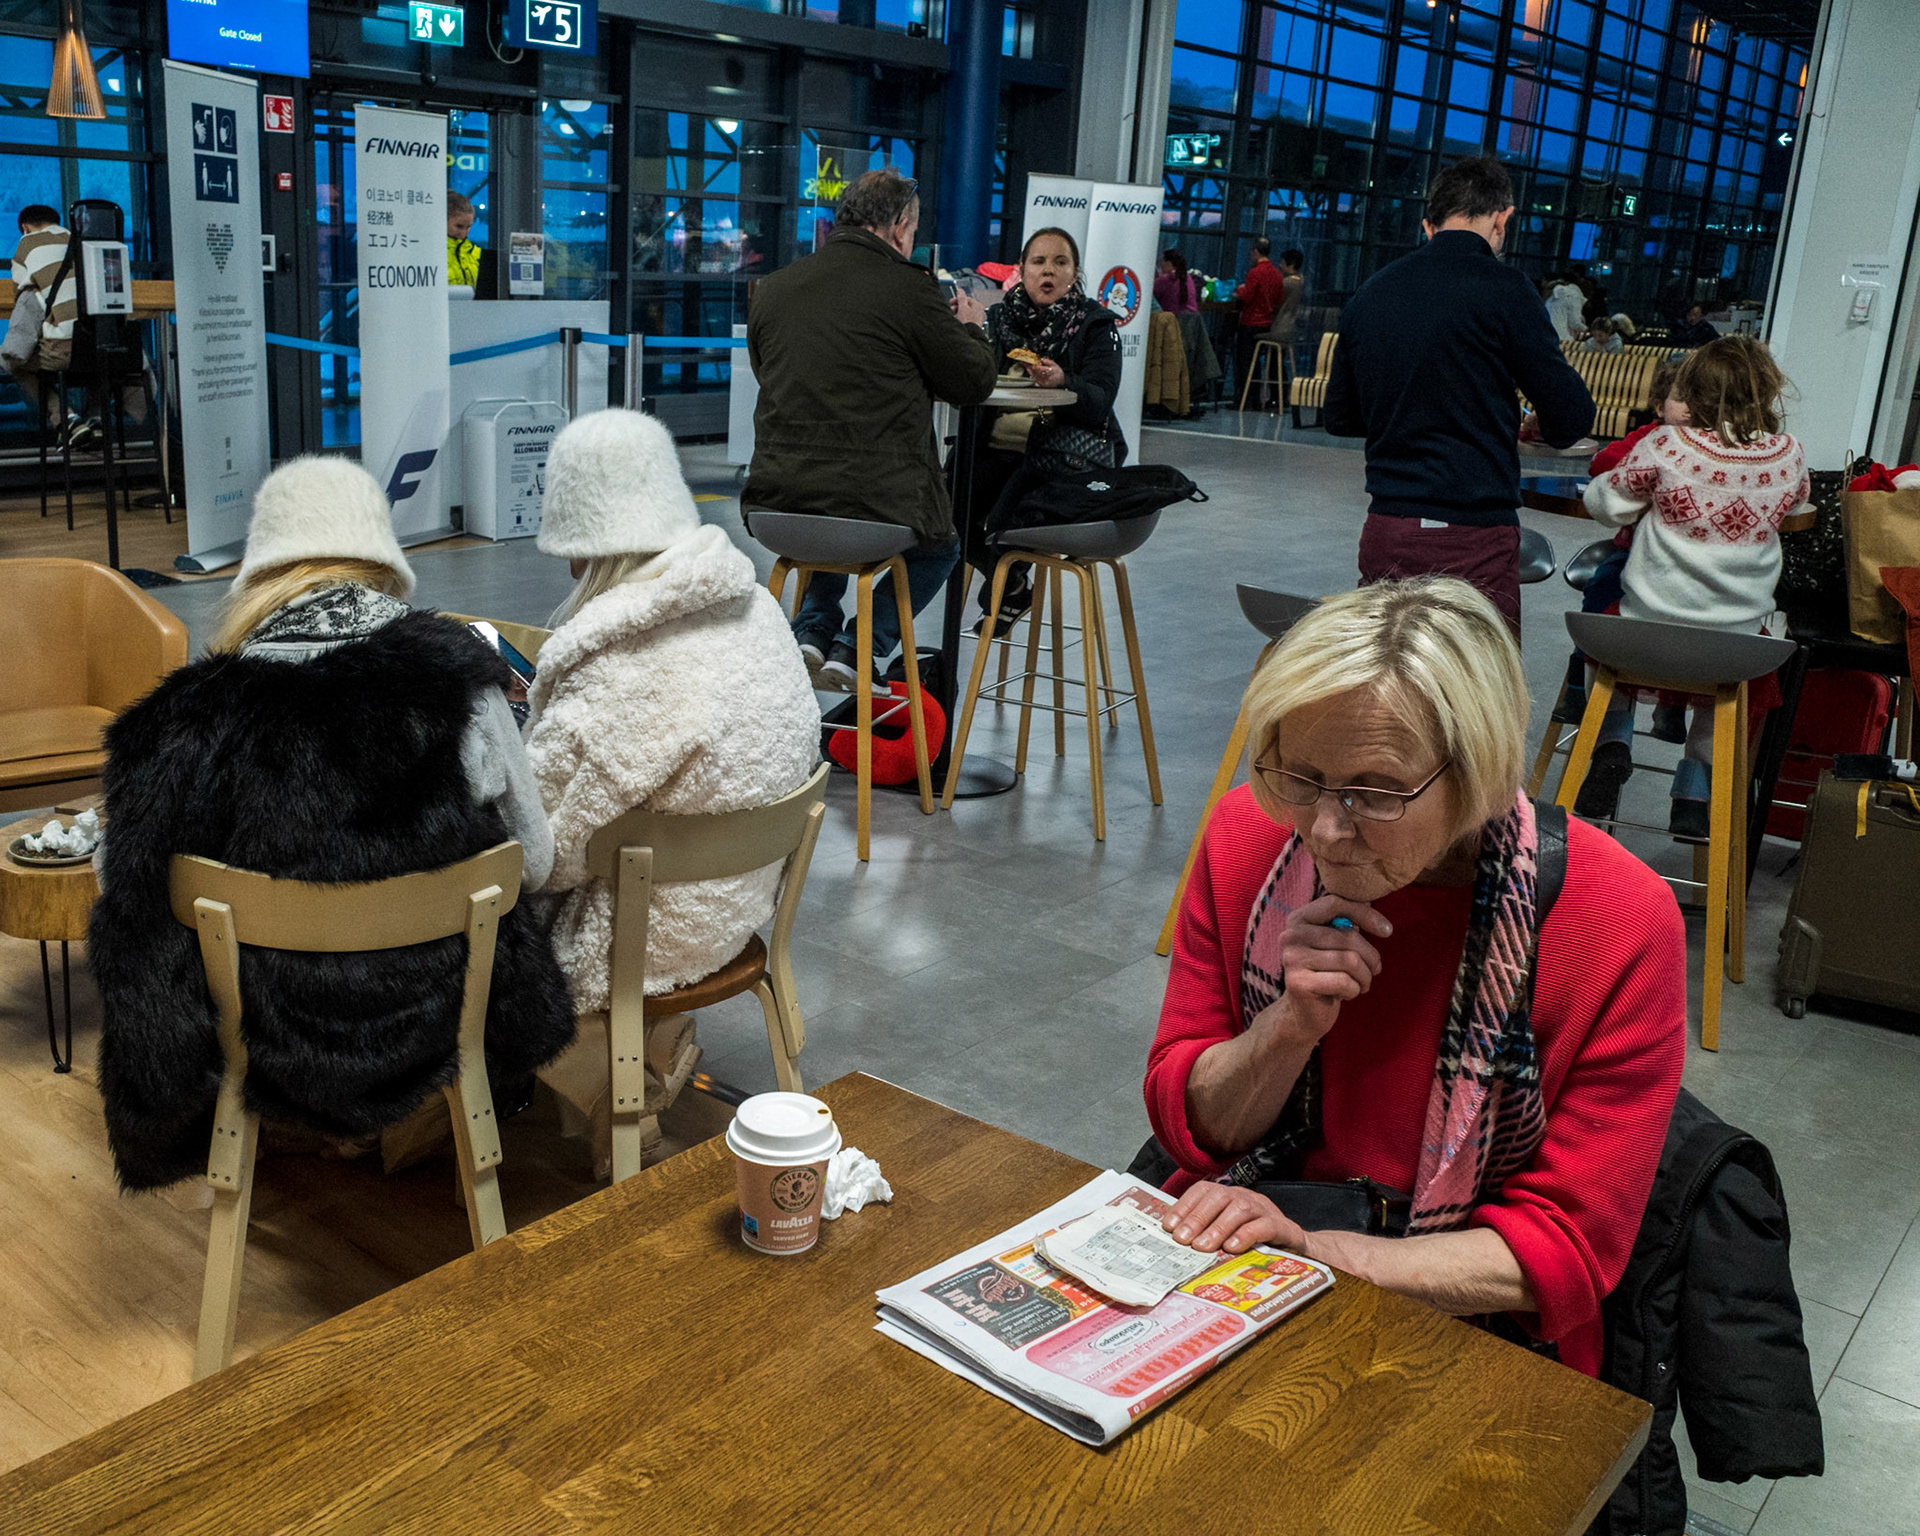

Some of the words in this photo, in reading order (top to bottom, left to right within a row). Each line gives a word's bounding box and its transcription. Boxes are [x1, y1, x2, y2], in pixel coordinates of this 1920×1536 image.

[554, 7, 572, 42] 5
[219, 27, 237, 39] Gate
[239, 30, 262, 42] Closed
[365, 137, 440, 159] FINNAIR
[366, 188, 403, 202] 이코노미
[406, 190, 434, 205] 클래스
[1033, 194, 1088, 209] FINNAIR
[1095, 200, 1157, 215] FINNAIR
[367, 210, 394, 226] 经济舱
[368, 233, 420, 248] エコノミー
[368, 265, 438, 288] ECONOMY
[507, 424, 556, 436] FINNAIR
[513, 446, 549, 454] ALLOWANCE
[770, 1215, 813, 1229] LAVAZZA
[1290, 1271, 1323, 1293] Joulukuun
[1250, 1290, 1294, 1317] Avaintarjous
